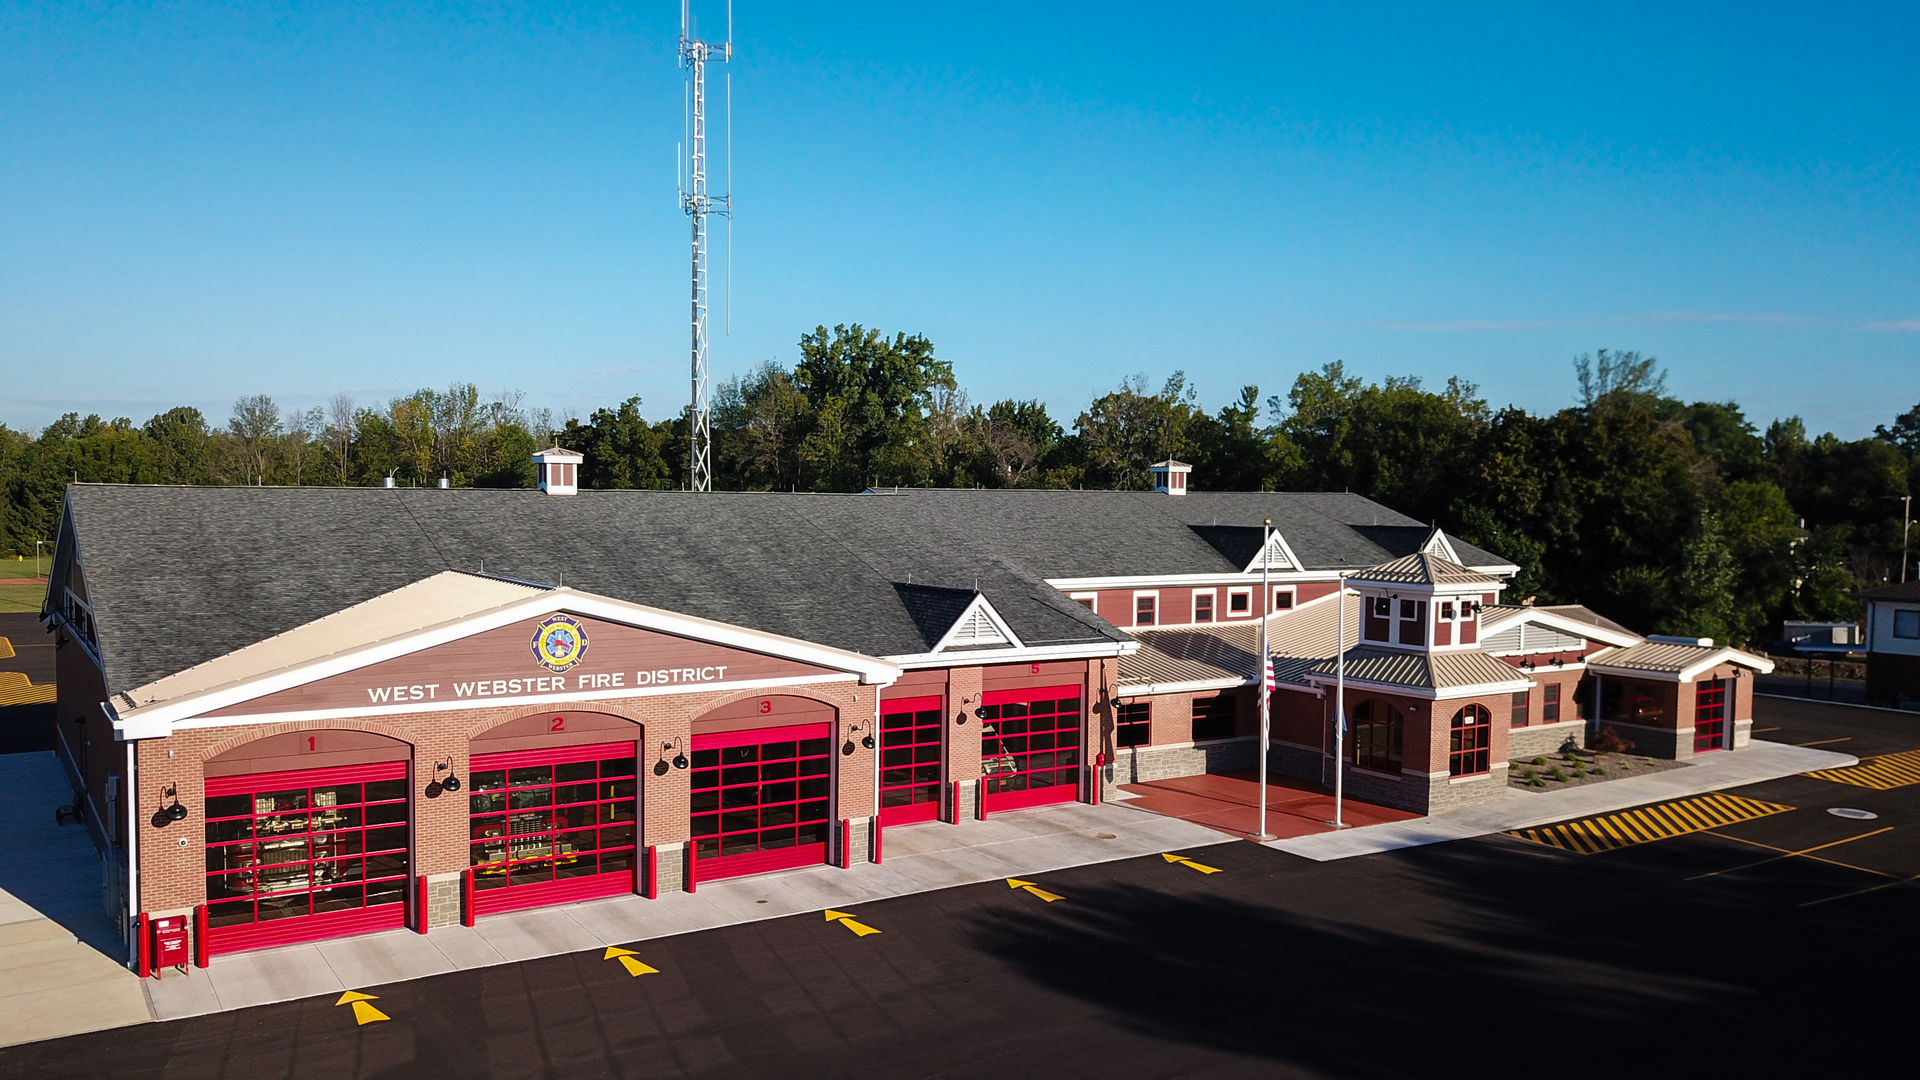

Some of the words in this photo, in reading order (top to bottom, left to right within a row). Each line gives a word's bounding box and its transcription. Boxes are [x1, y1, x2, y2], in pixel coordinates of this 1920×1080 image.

[532, 641, 539, 649] F
[1031, 663, 1040, 674] 5
[367, 684, 440, 703] WEST
[453, 676, 566, 698] WEBSTER
[578, 672, 625, 689] FIRE
[637, 665, 728, 686] DISTRICT
[760, 700, 772, 714] 3
[551, 716, 565, 732] 2
[308, 736, 316, 751] 1
